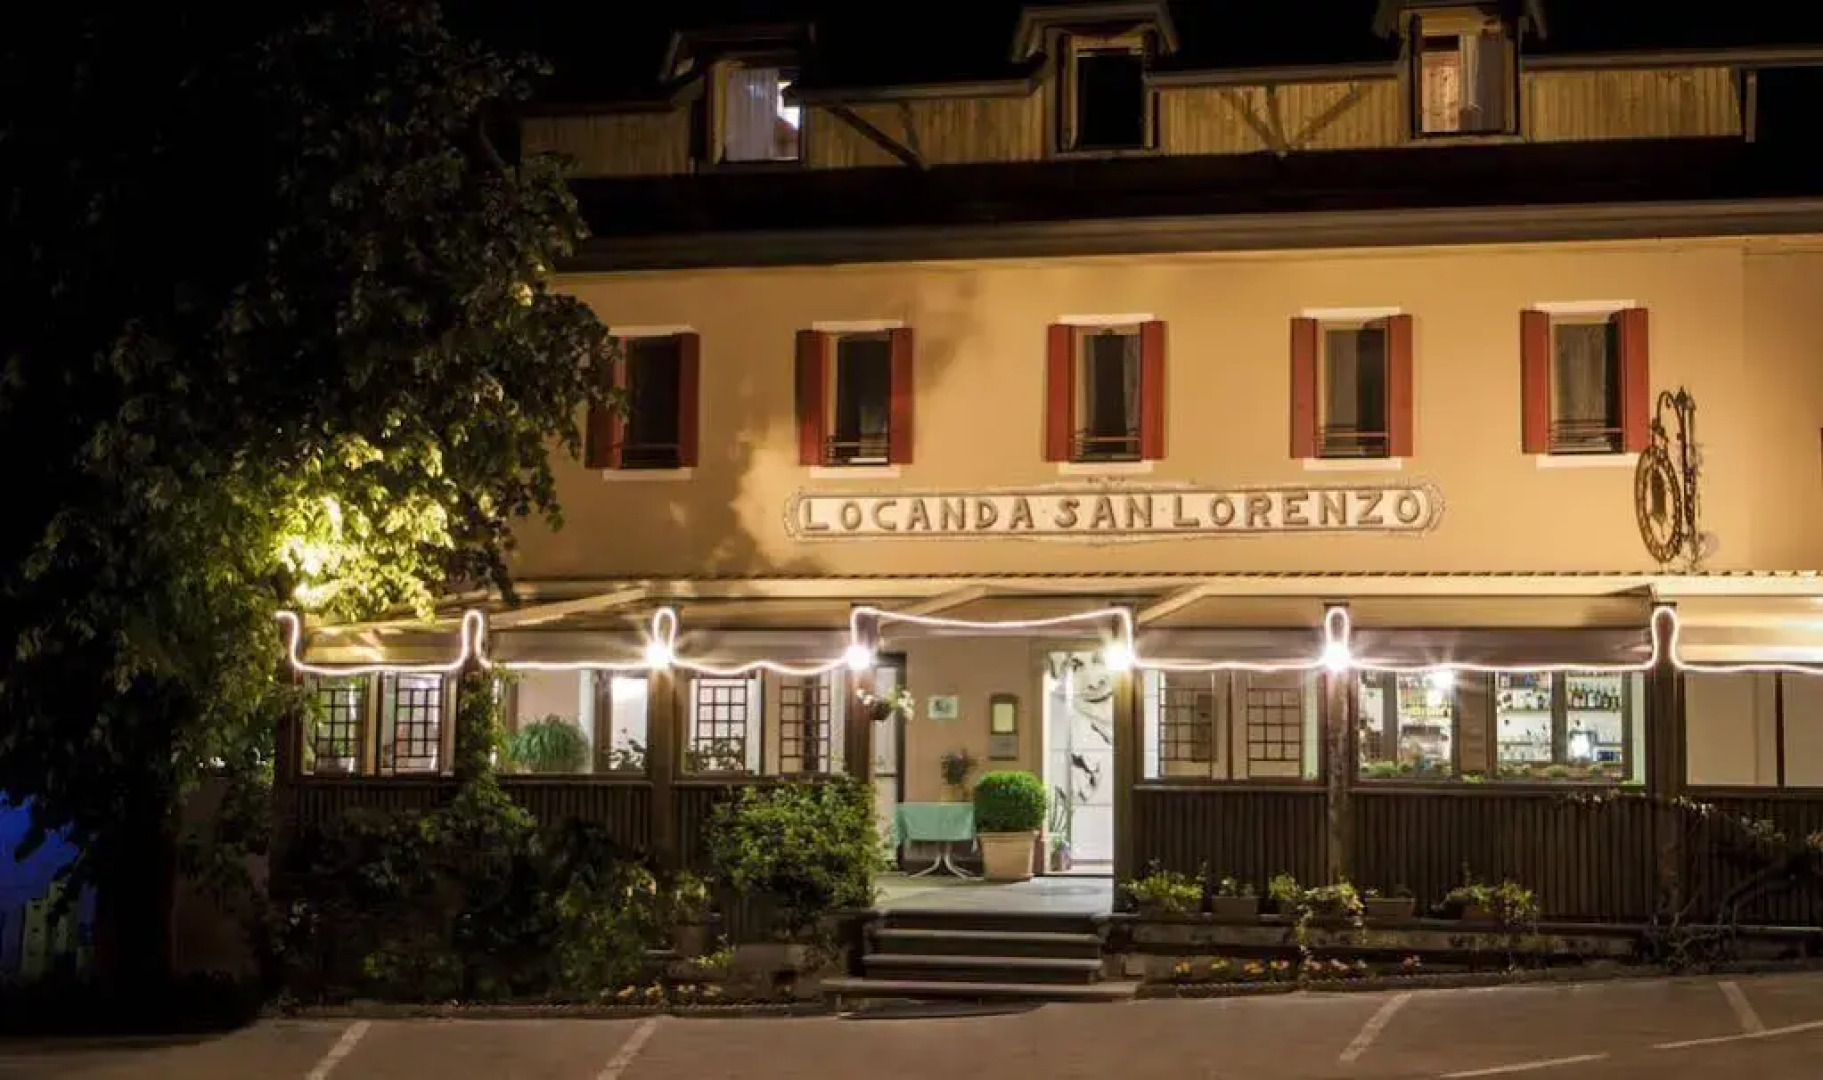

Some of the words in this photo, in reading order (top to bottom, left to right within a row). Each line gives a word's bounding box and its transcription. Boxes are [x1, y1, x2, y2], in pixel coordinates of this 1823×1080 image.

[804, 498, 1034, 531] LOCANDA
[1054, 496, 1153, 528] SAN
[1173, 491, 1421, 527] LORENZO
